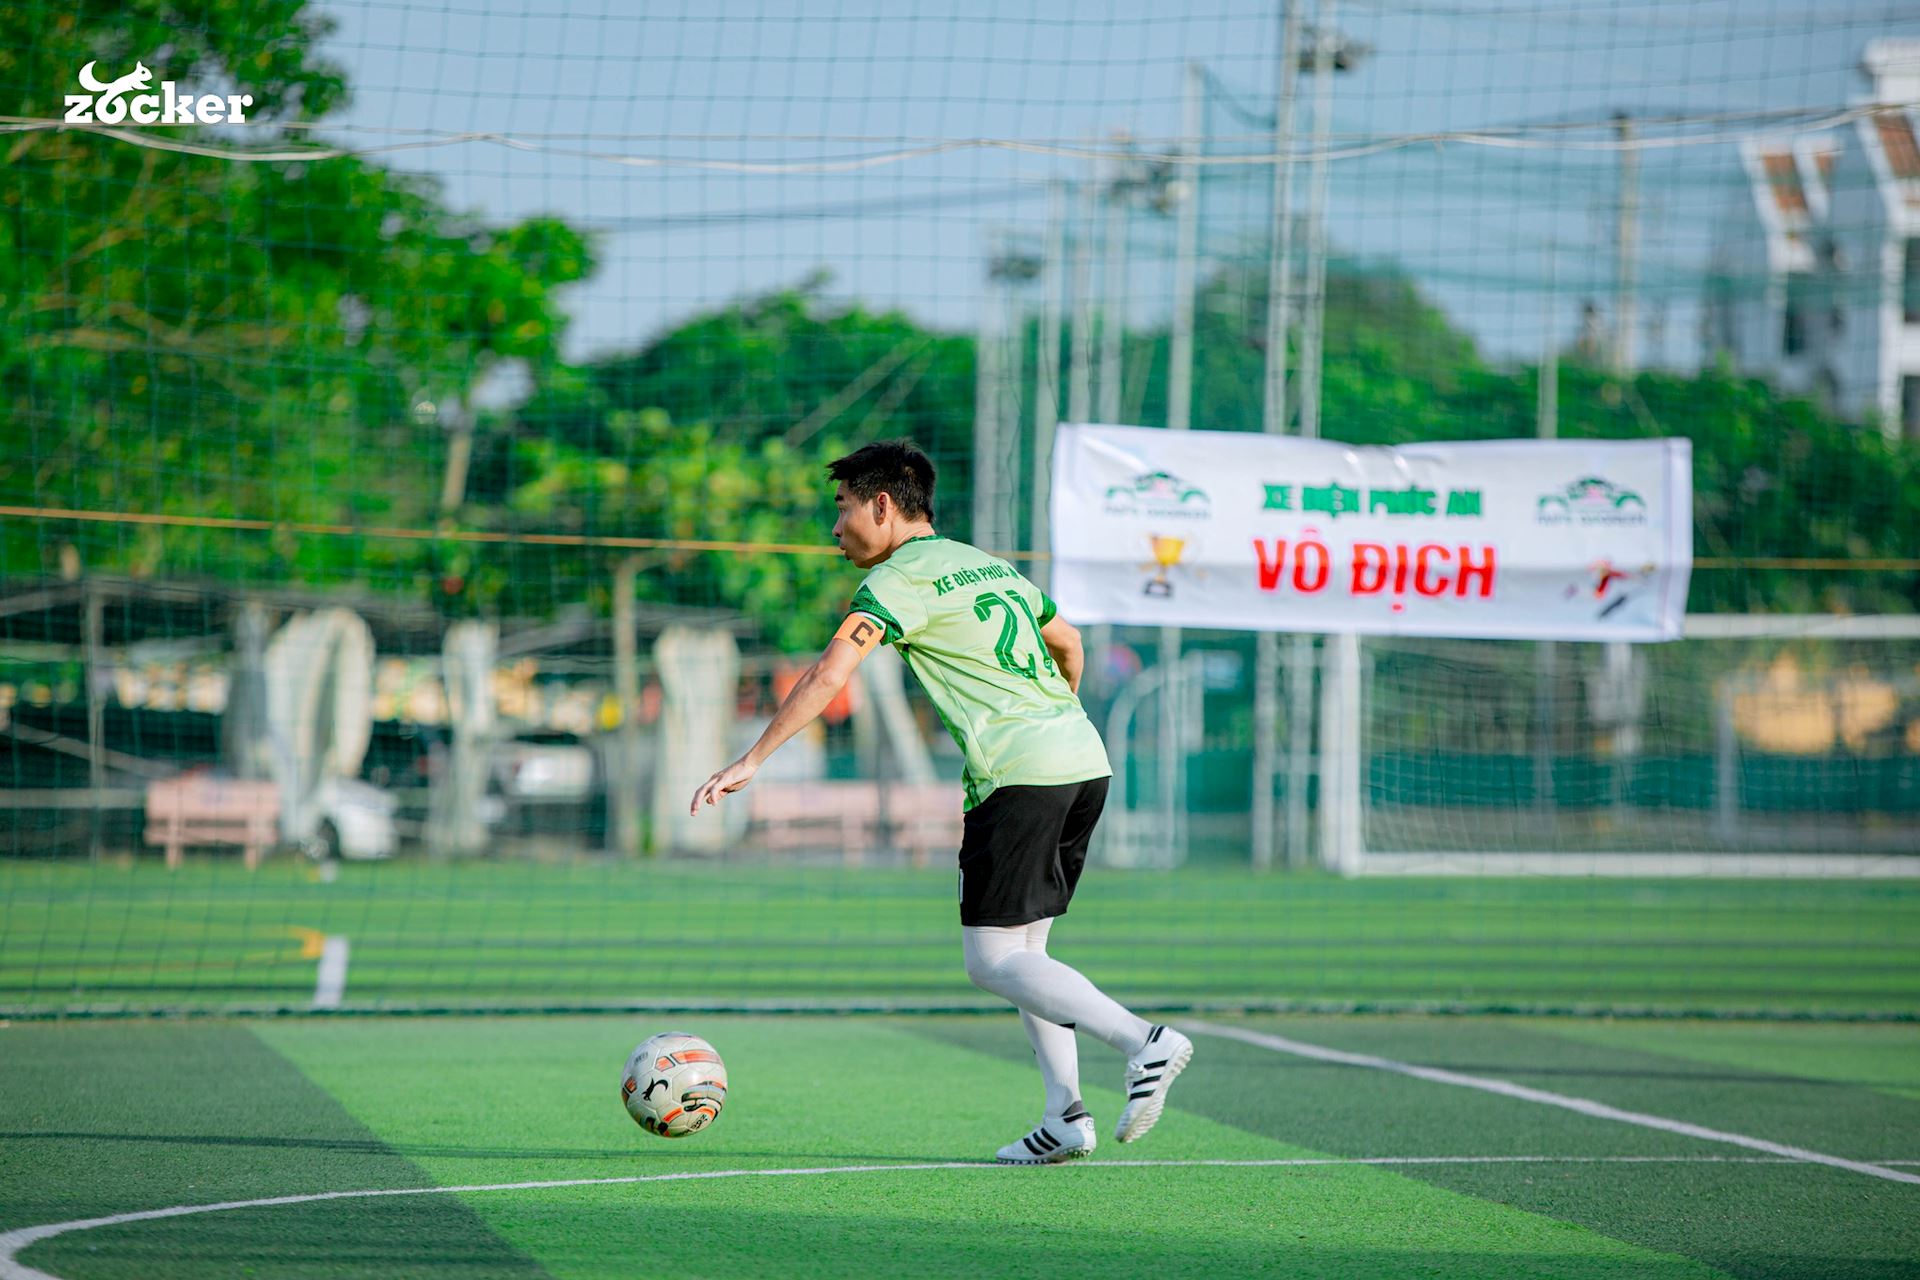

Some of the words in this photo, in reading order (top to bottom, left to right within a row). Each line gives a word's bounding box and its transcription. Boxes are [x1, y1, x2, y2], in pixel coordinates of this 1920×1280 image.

[1262, 484, 1293, 510] XE
[932, 576, 955, 597] XE
[977, 562, 1009, 581] PHÚC
[1253, 527, 1329, 593] VÔ
[1351, 543, 1495, 611] ĐỊCH
[849, 621, 875, 648] C
[973, 589, 1056, 680] 21
